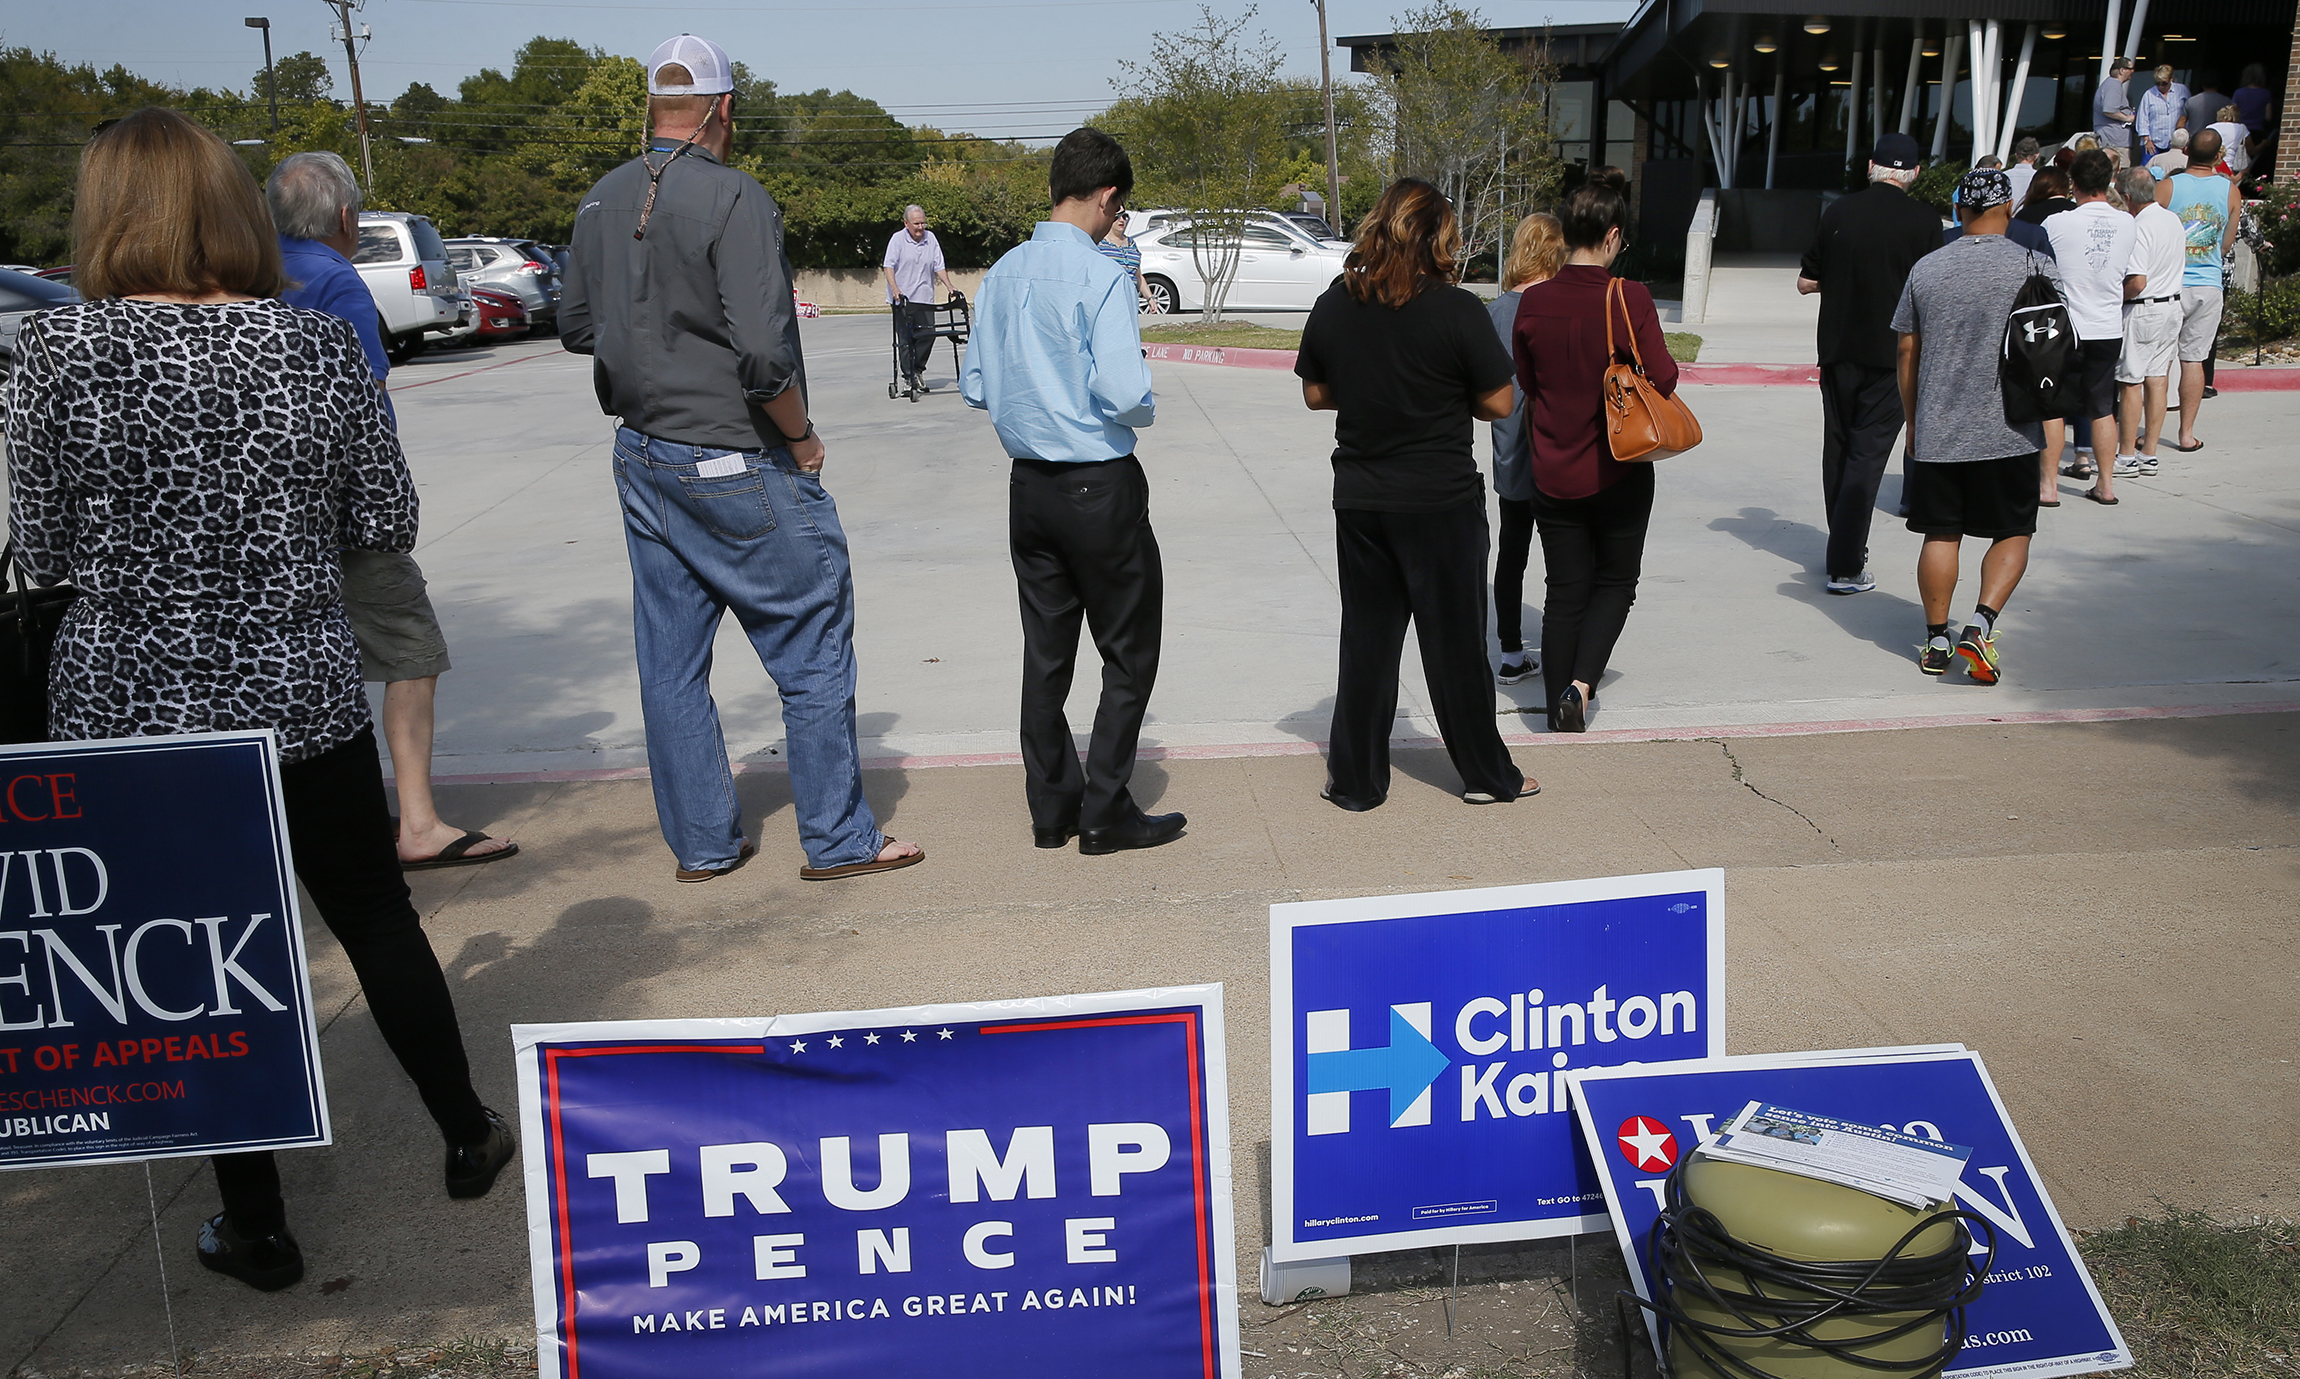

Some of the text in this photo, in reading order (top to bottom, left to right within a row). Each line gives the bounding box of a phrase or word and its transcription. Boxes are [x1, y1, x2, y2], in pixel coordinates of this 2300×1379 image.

[1151, 346, 1170, 358] LANE
[1182, 348, 1193, 360] NO
[1195, 350, 1225, 363] PARKING
[1455, 984, 1696, 1056] Clinton
[0, 1031, 250, 1074] T OF APPEALS
[1461, 1051, 1646, 1122] Kai
[1764, 1112, 1898, 1143] sense into Austin!
[1767, 1106, 1955, 1152] Let's vote some common
[587, 1123, 1171, 1224] TRUMP
[1304, 1214, 1379, 1228] hillaryclinton.com
[1536, 1197, 1555, 1206] Text
[1556, 1195, 1571, 1204] GO
[648, 1217, 1116, 1288] PENCE
[2025, 1264, 2053, 1280] 102
[633, 1285, 1136, 1335] MAKE AMERICA GREAT AGAIN!
